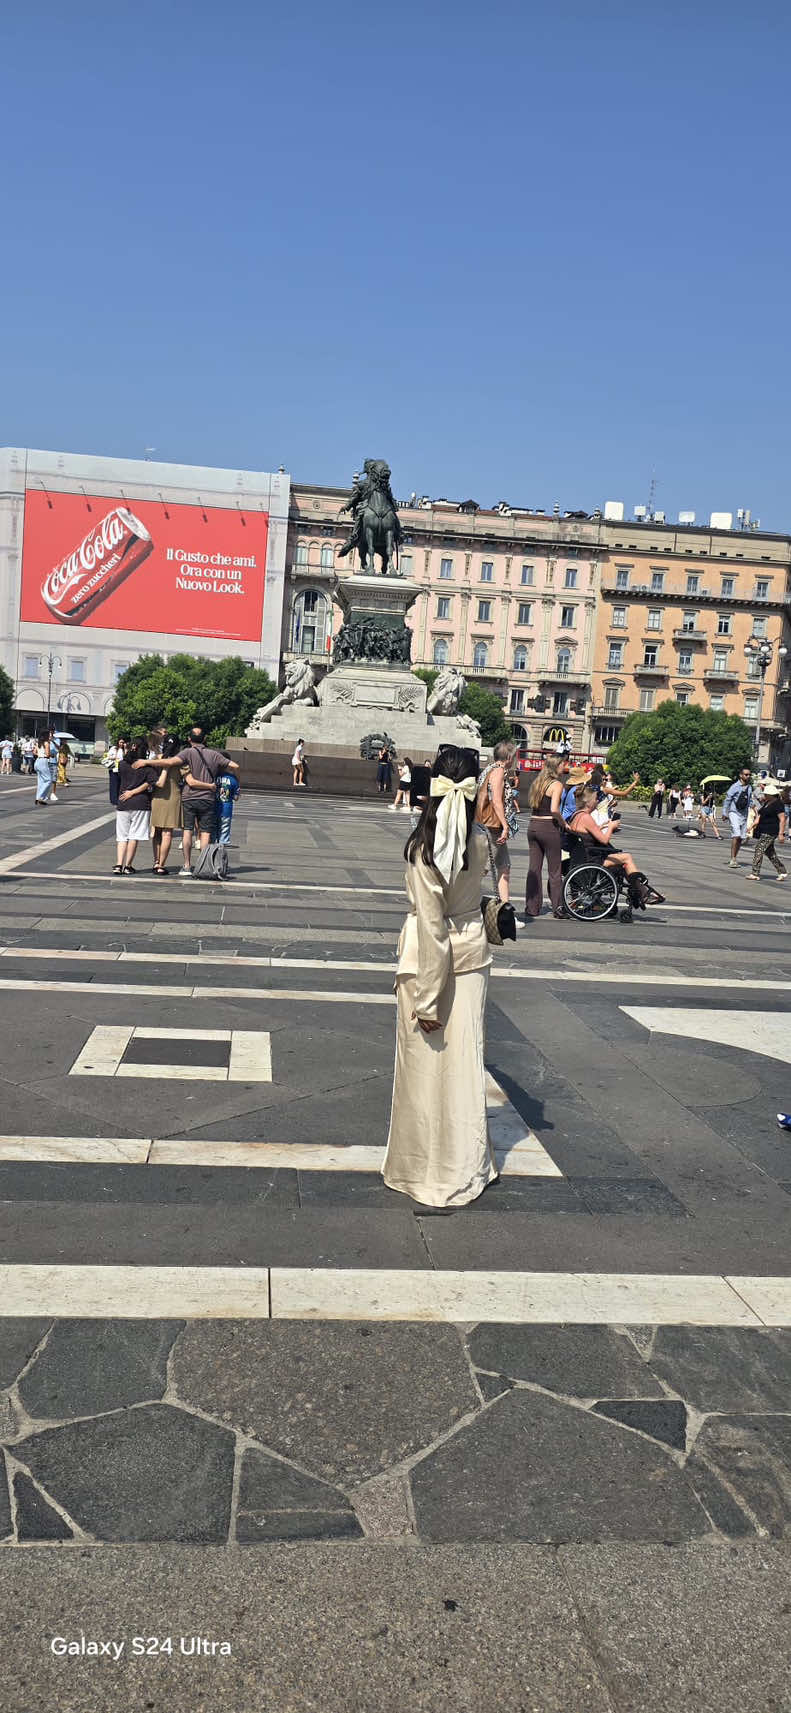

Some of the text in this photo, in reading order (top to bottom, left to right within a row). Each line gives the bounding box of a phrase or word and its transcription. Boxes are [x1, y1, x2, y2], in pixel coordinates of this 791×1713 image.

[167, 548, 257, 568] Il Gusto che ami.
[71, 553, 121, 604] zero zuccheri
[180, 564, 242, 580] Ora con un
[176, 577, 245, 594] Nuovo Look.
